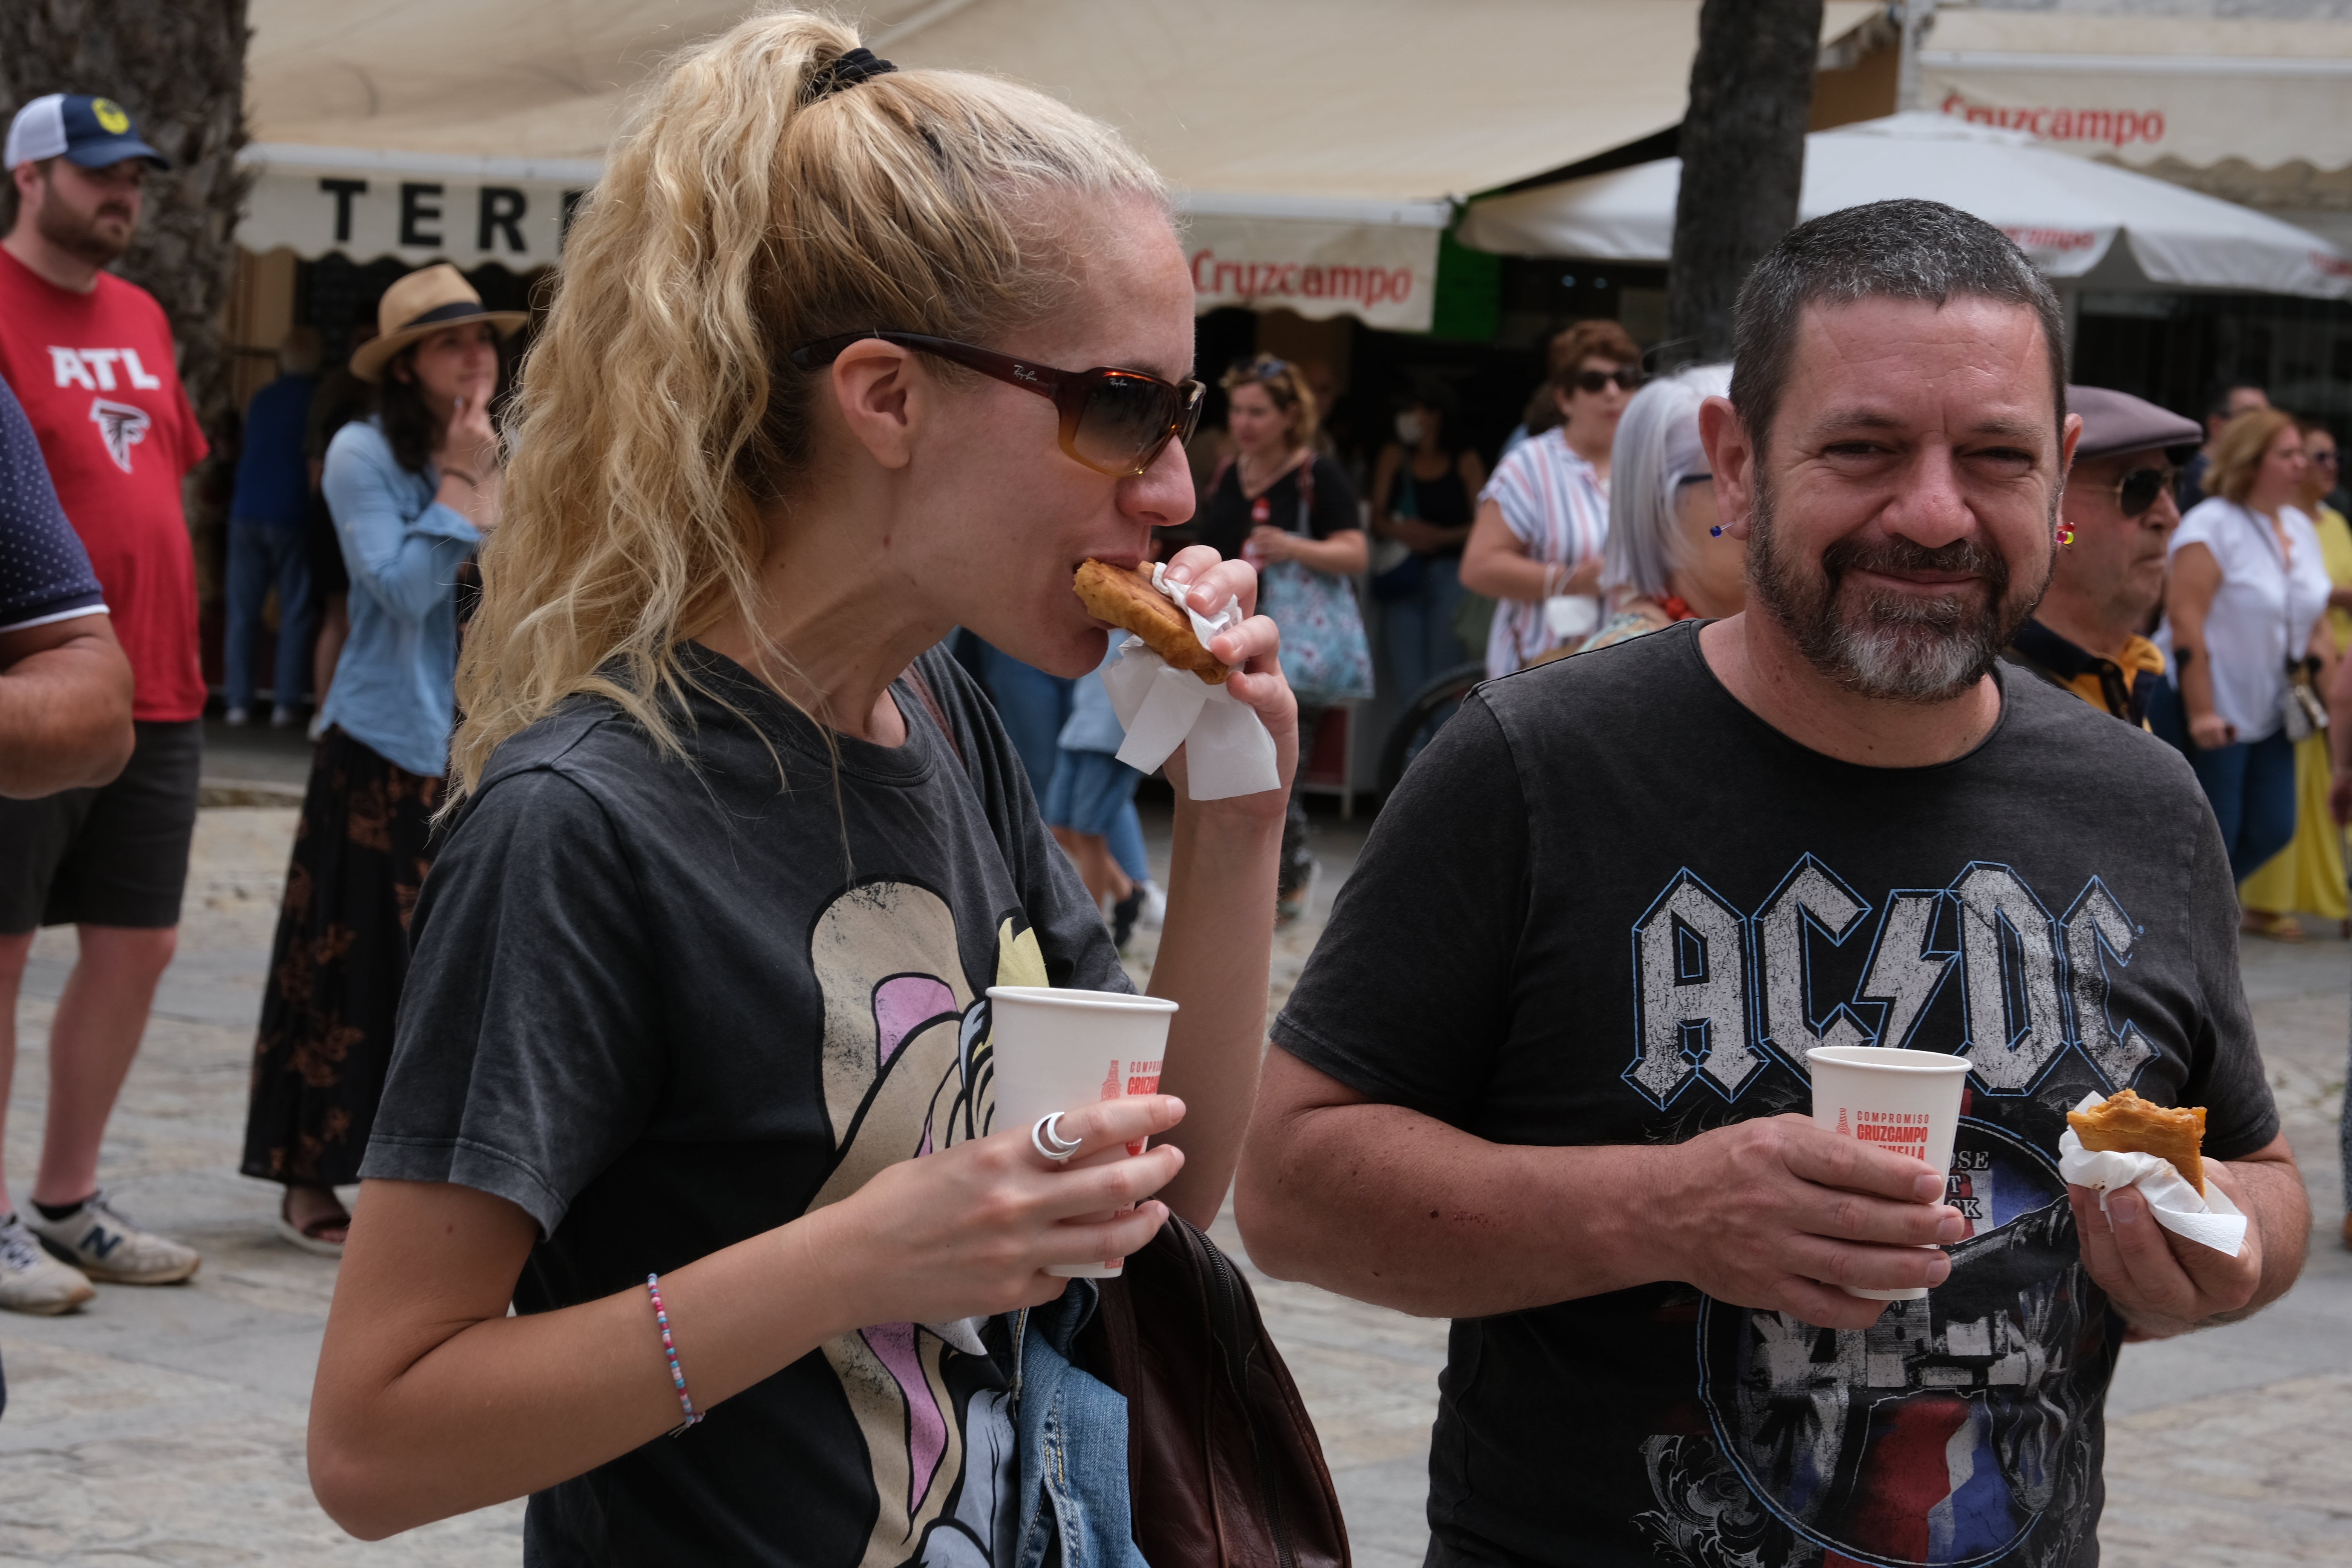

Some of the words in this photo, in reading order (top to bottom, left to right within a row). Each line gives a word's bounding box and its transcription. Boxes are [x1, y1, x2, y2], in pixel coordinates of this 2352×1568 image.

[320, 178, 592, 253] TER
[1191, 247, 1413, 310] Cruzcampo
[47, 345, 161, 391] ATL
[1857, 1111, 1929, 1124] COMPROMISO
[1857, 1124, 1928, 1143] CRUZCAMPO
